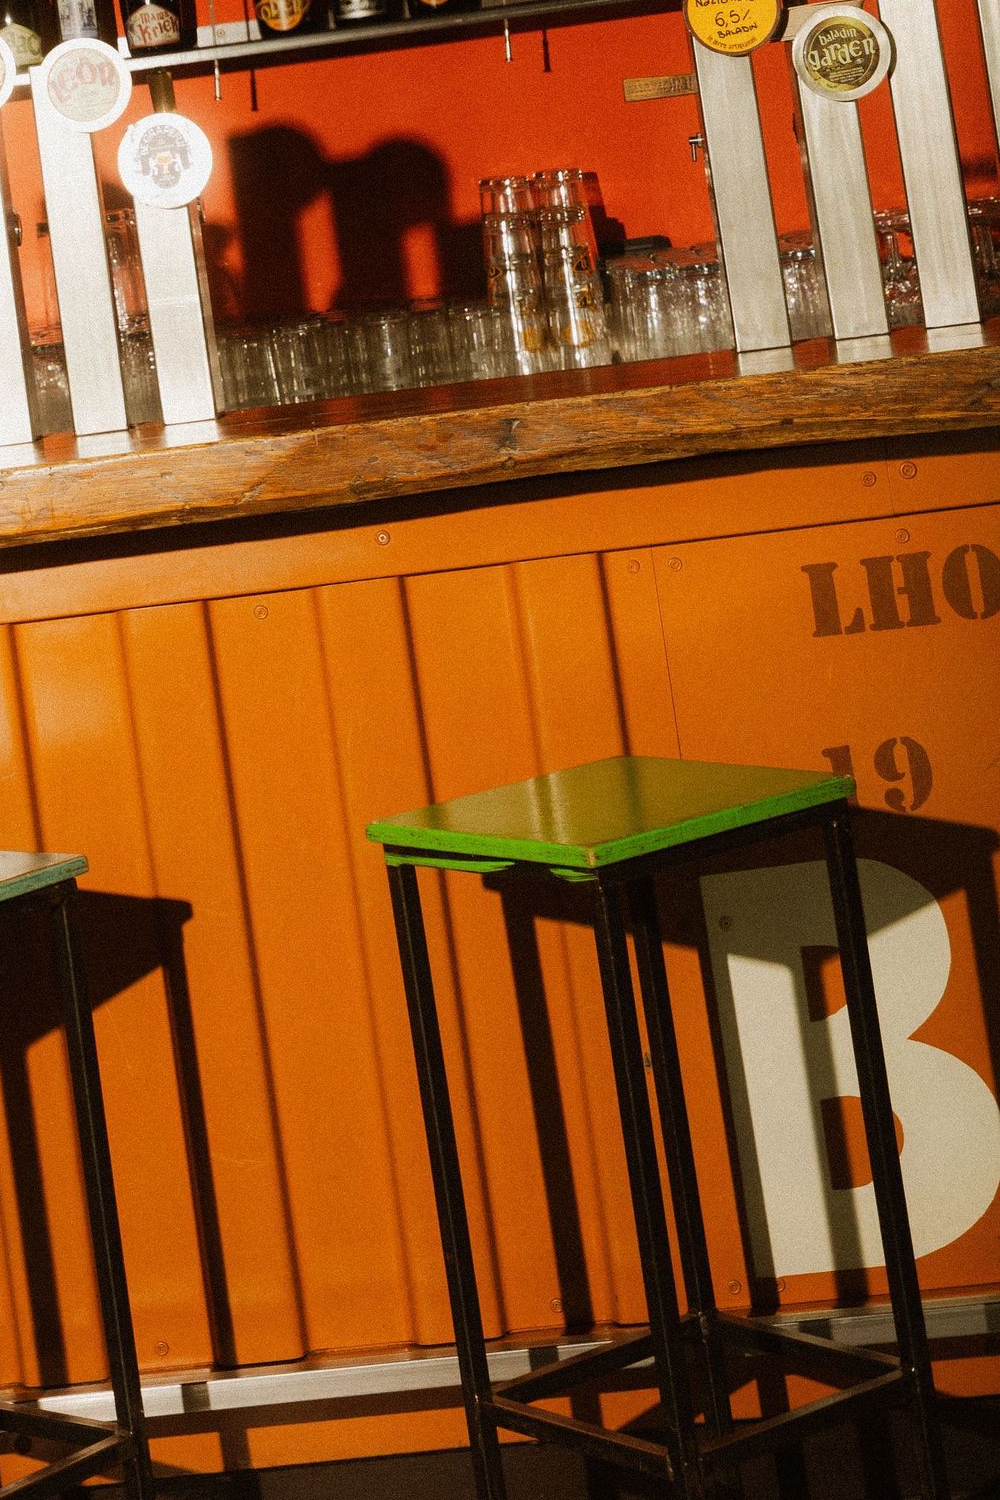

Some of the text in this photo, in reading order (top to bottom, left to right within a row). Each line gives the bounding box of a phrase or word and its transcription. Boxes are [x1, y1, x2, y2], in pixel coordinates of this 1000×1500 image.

[717, 22, 758, 39] BALADIN
[818, 25, 857, 46] baladin
[700, 858, 1000, 1278] B
